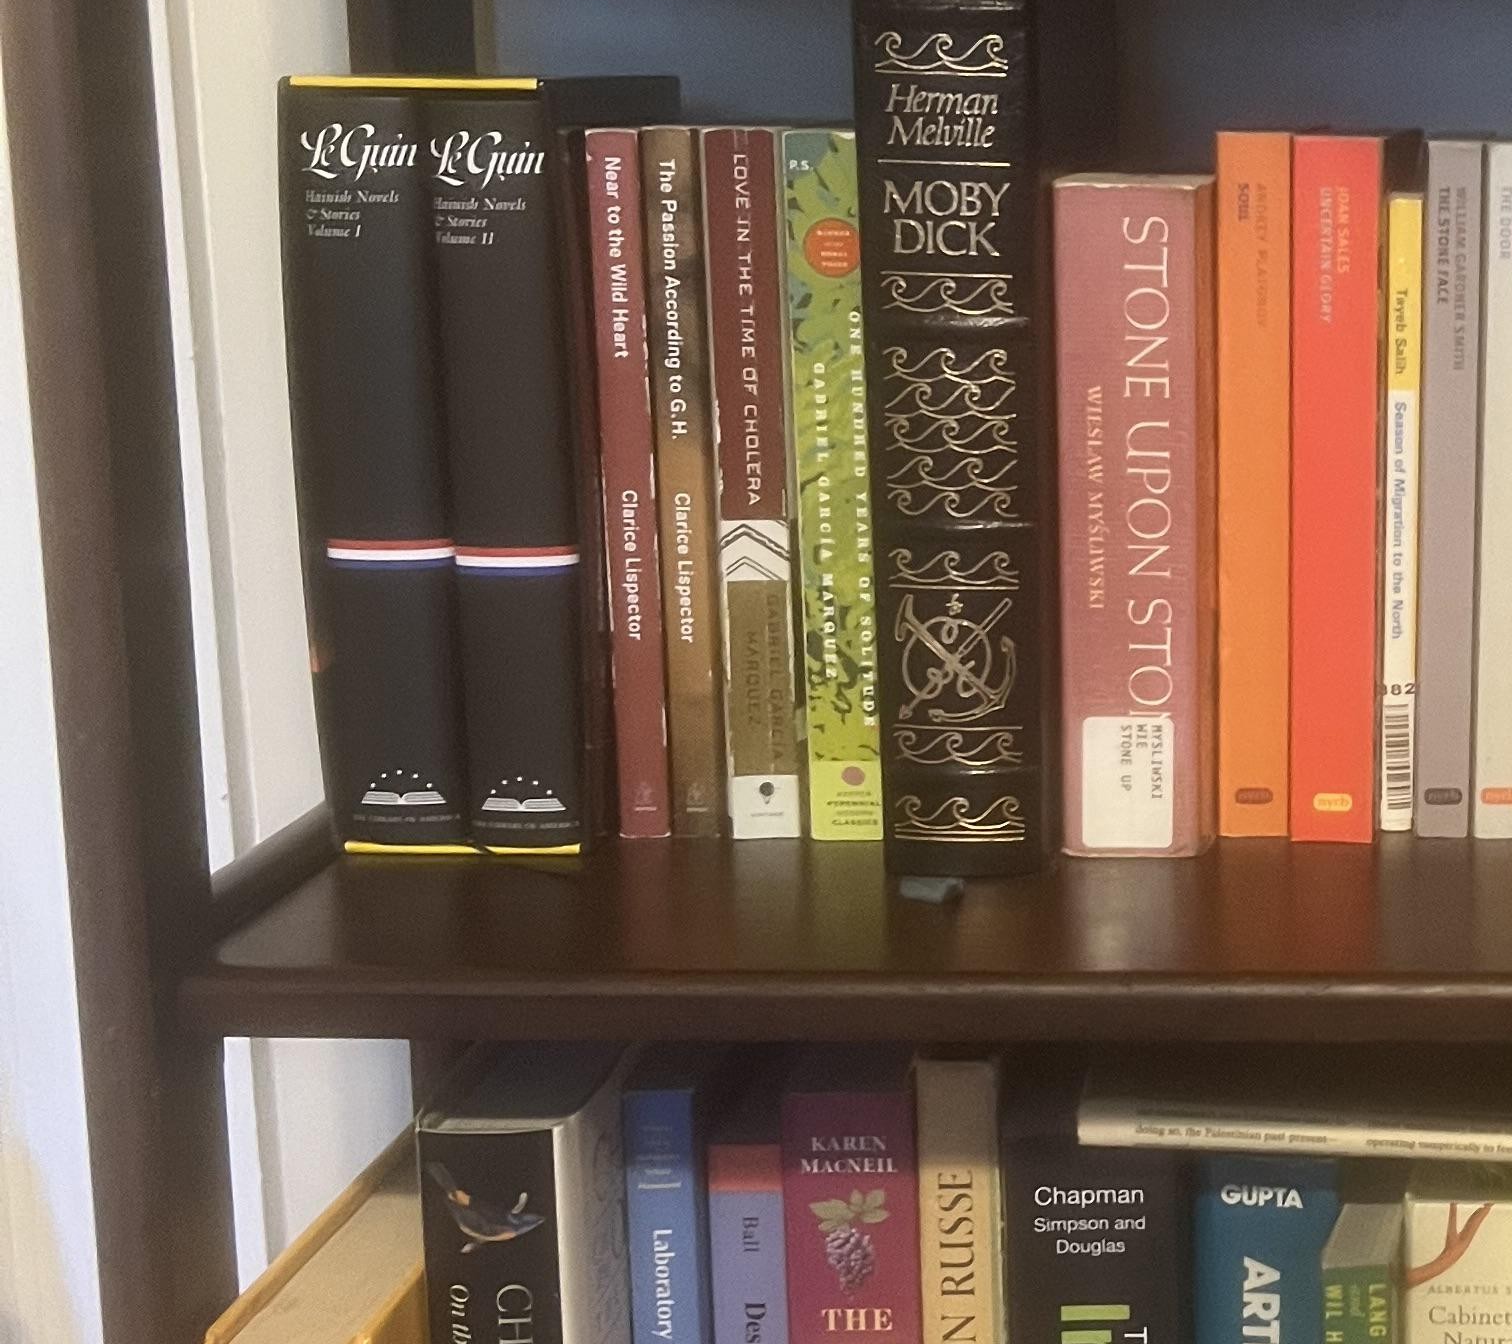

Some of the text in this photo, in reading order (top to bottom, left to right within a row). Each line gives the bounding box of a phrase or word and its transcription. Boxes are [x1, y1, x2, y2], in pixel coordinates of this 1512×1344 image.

[883, 179, 1011, 217] MOBY
[603, 156, 629, 359] Near to the Wild Heart
[893, 219, 1001, 257] DICK
[1122, 215, 1173, 579] STONE UPON
[621, 489, 642, 641] Clarice Lispector
[1120, 725, 1133, 792] STONE UP
[1151, 725, 1163, 800] MYSLIWSKI
[1034, 1186, 1145, 1208] Chapman
[1033, 1215, 1147, 1234] Simpson and
[1056, 1238, 1126, 1257] Douglas
[652, 1229, 676, 1340] Laboratory
[821, 1308, 894, 1332] THE
